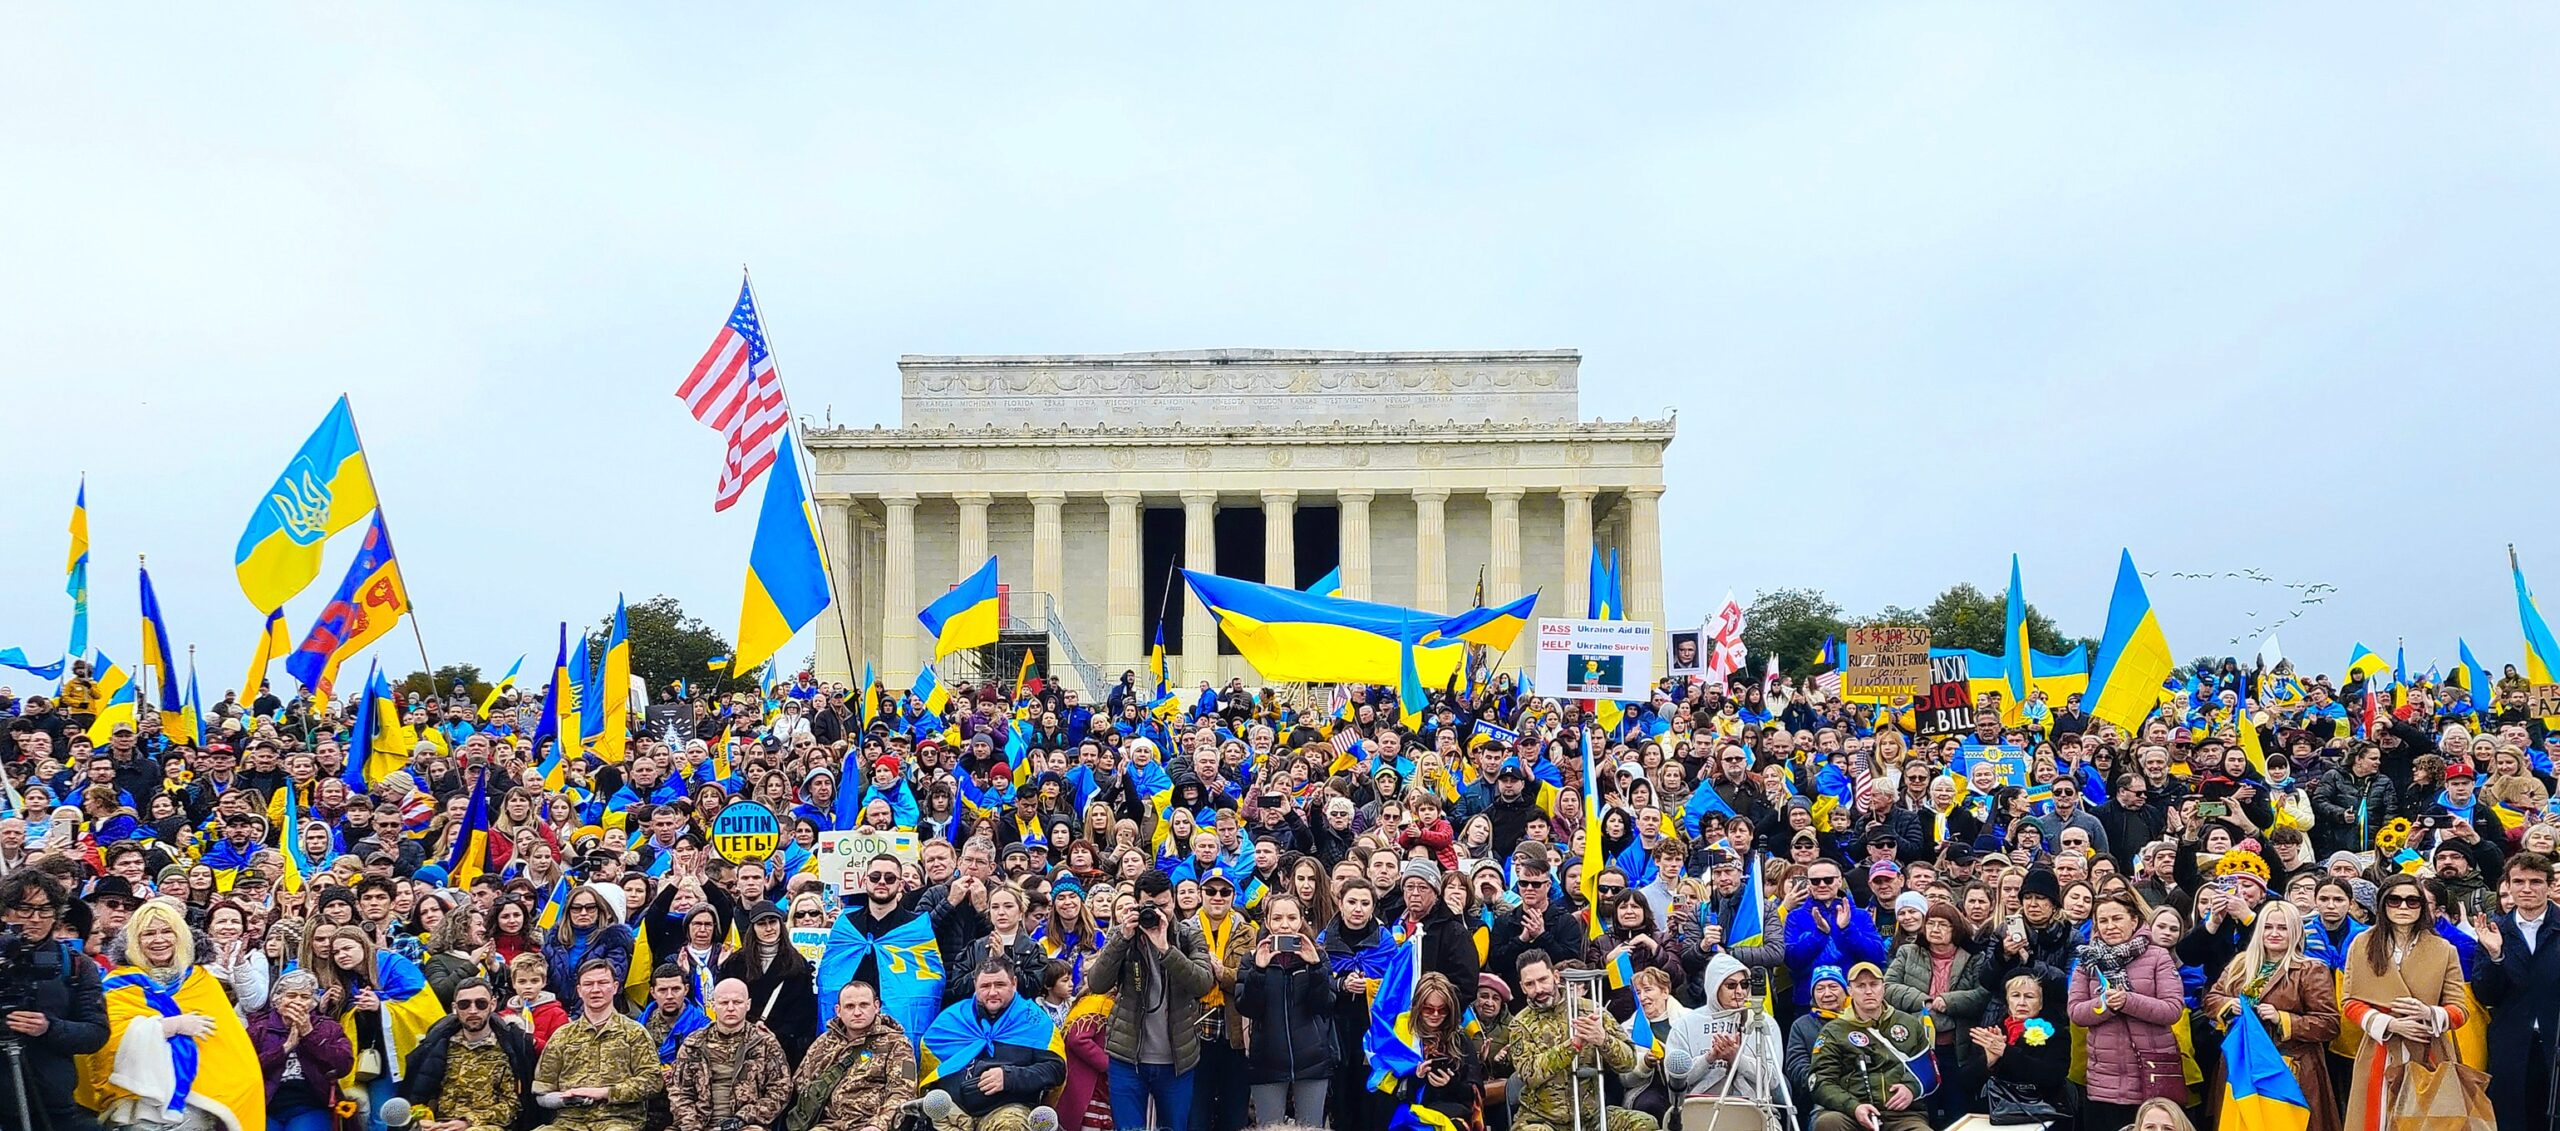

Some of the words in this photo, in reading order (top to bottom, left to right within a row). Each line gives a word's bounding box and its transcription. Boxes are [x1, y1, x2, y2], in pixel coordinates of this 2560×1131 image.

[1004, 399, 1034, 407] FLORIDA
[1253, 397, 1283, 405] OREGON
[1542, 624, 1571, 633] PASS
[1577, 625, 1615, 634] Ukraine
[1618, 626, 1632, 634] Aid
[1635, 627, 1650, 635] Bill
[1542, 640, 1571, 649] HELP
[1577, 642, 1613, 651] Ukraine
[1614, 644, 1649, 652] Survive
[1874, 645, 1894, 653] YEARS
[1849, 654, 1894, 667] RUZZIAN
[1897, 653, 1929, 667] TERROR
[1870, 668, 1907, 678] against
[1582, 684, 1608, 692] RUSSIA
[1852, 677, 1918, 694] UKRAINE
[1937, 707, 1976, 732] BILL
[1478, 724, 1493, 736] WE
[731, 804, 760, 813] ПУТІН
[720, 816, 771, 833] PUTIN
[722, 835, 771, 852] ГЕТЬ!
[838, 838, 888, 856] GOOD
